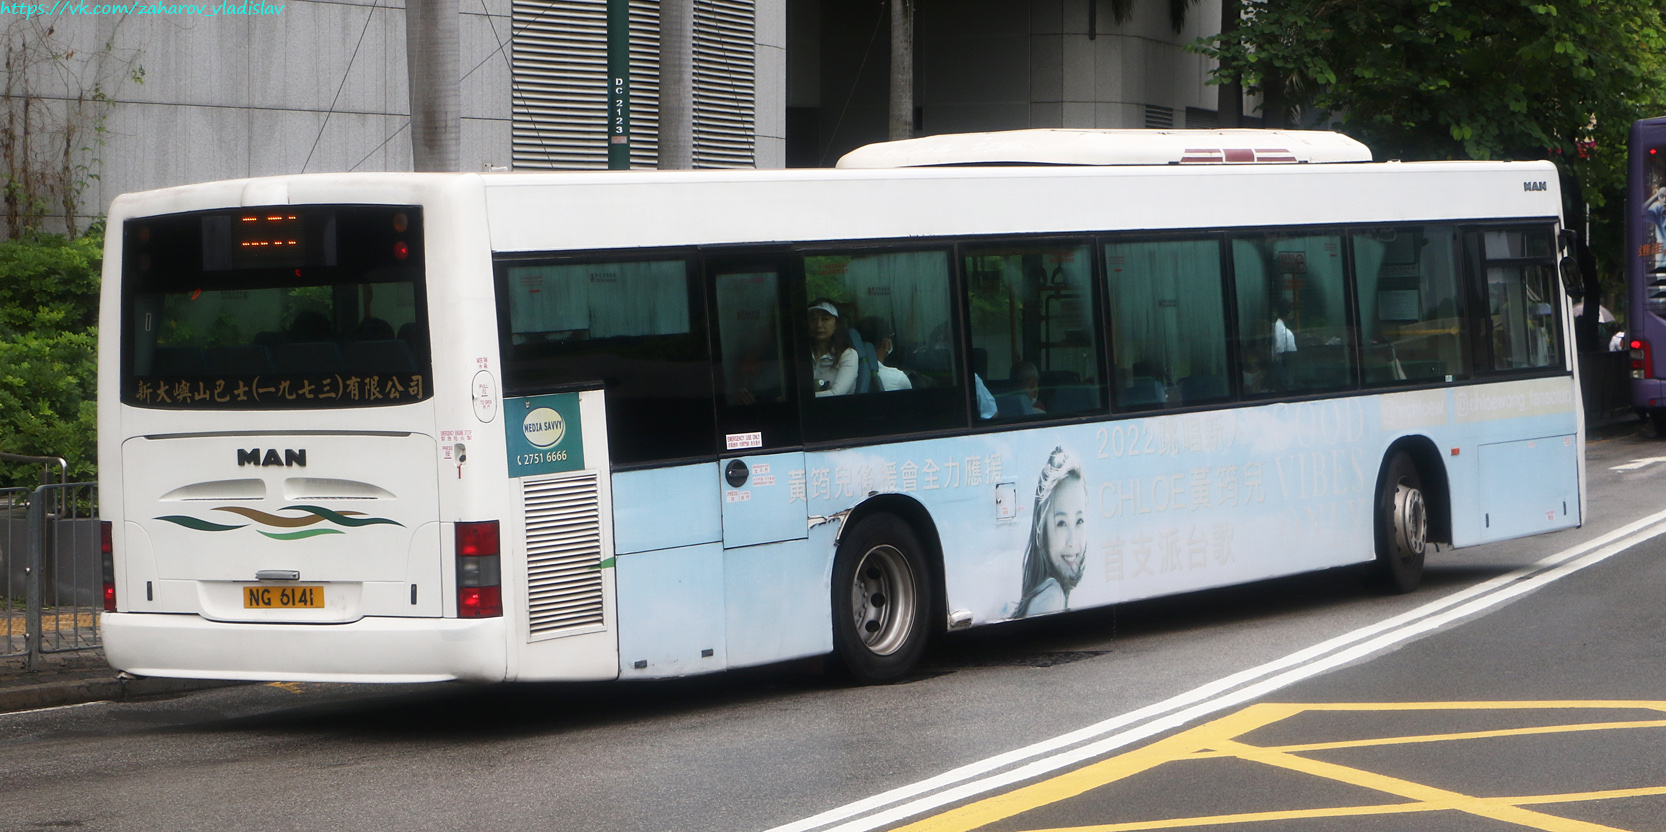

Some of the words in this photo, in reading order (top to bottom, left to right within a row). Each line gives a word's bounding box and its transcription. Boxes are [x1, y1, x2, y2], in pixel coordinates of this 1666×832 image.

[615, 77, 624, 95] DC
[615, 99, 624, 134] 2123
[1523, 181, 1547, 191] MAN
[524, 422, 543, 433] MEDIA
[544, 420, 563, 431] SAVVY
[237, 448, 306, 467] MAN
[524, 453, 544, 465] 2751
[546, 450, 567, 462] 6666
[1274, 446, 1365, 500] VIBES
[248, 588, 272, 606] NG
[280, 588, 314, 606] 6141
